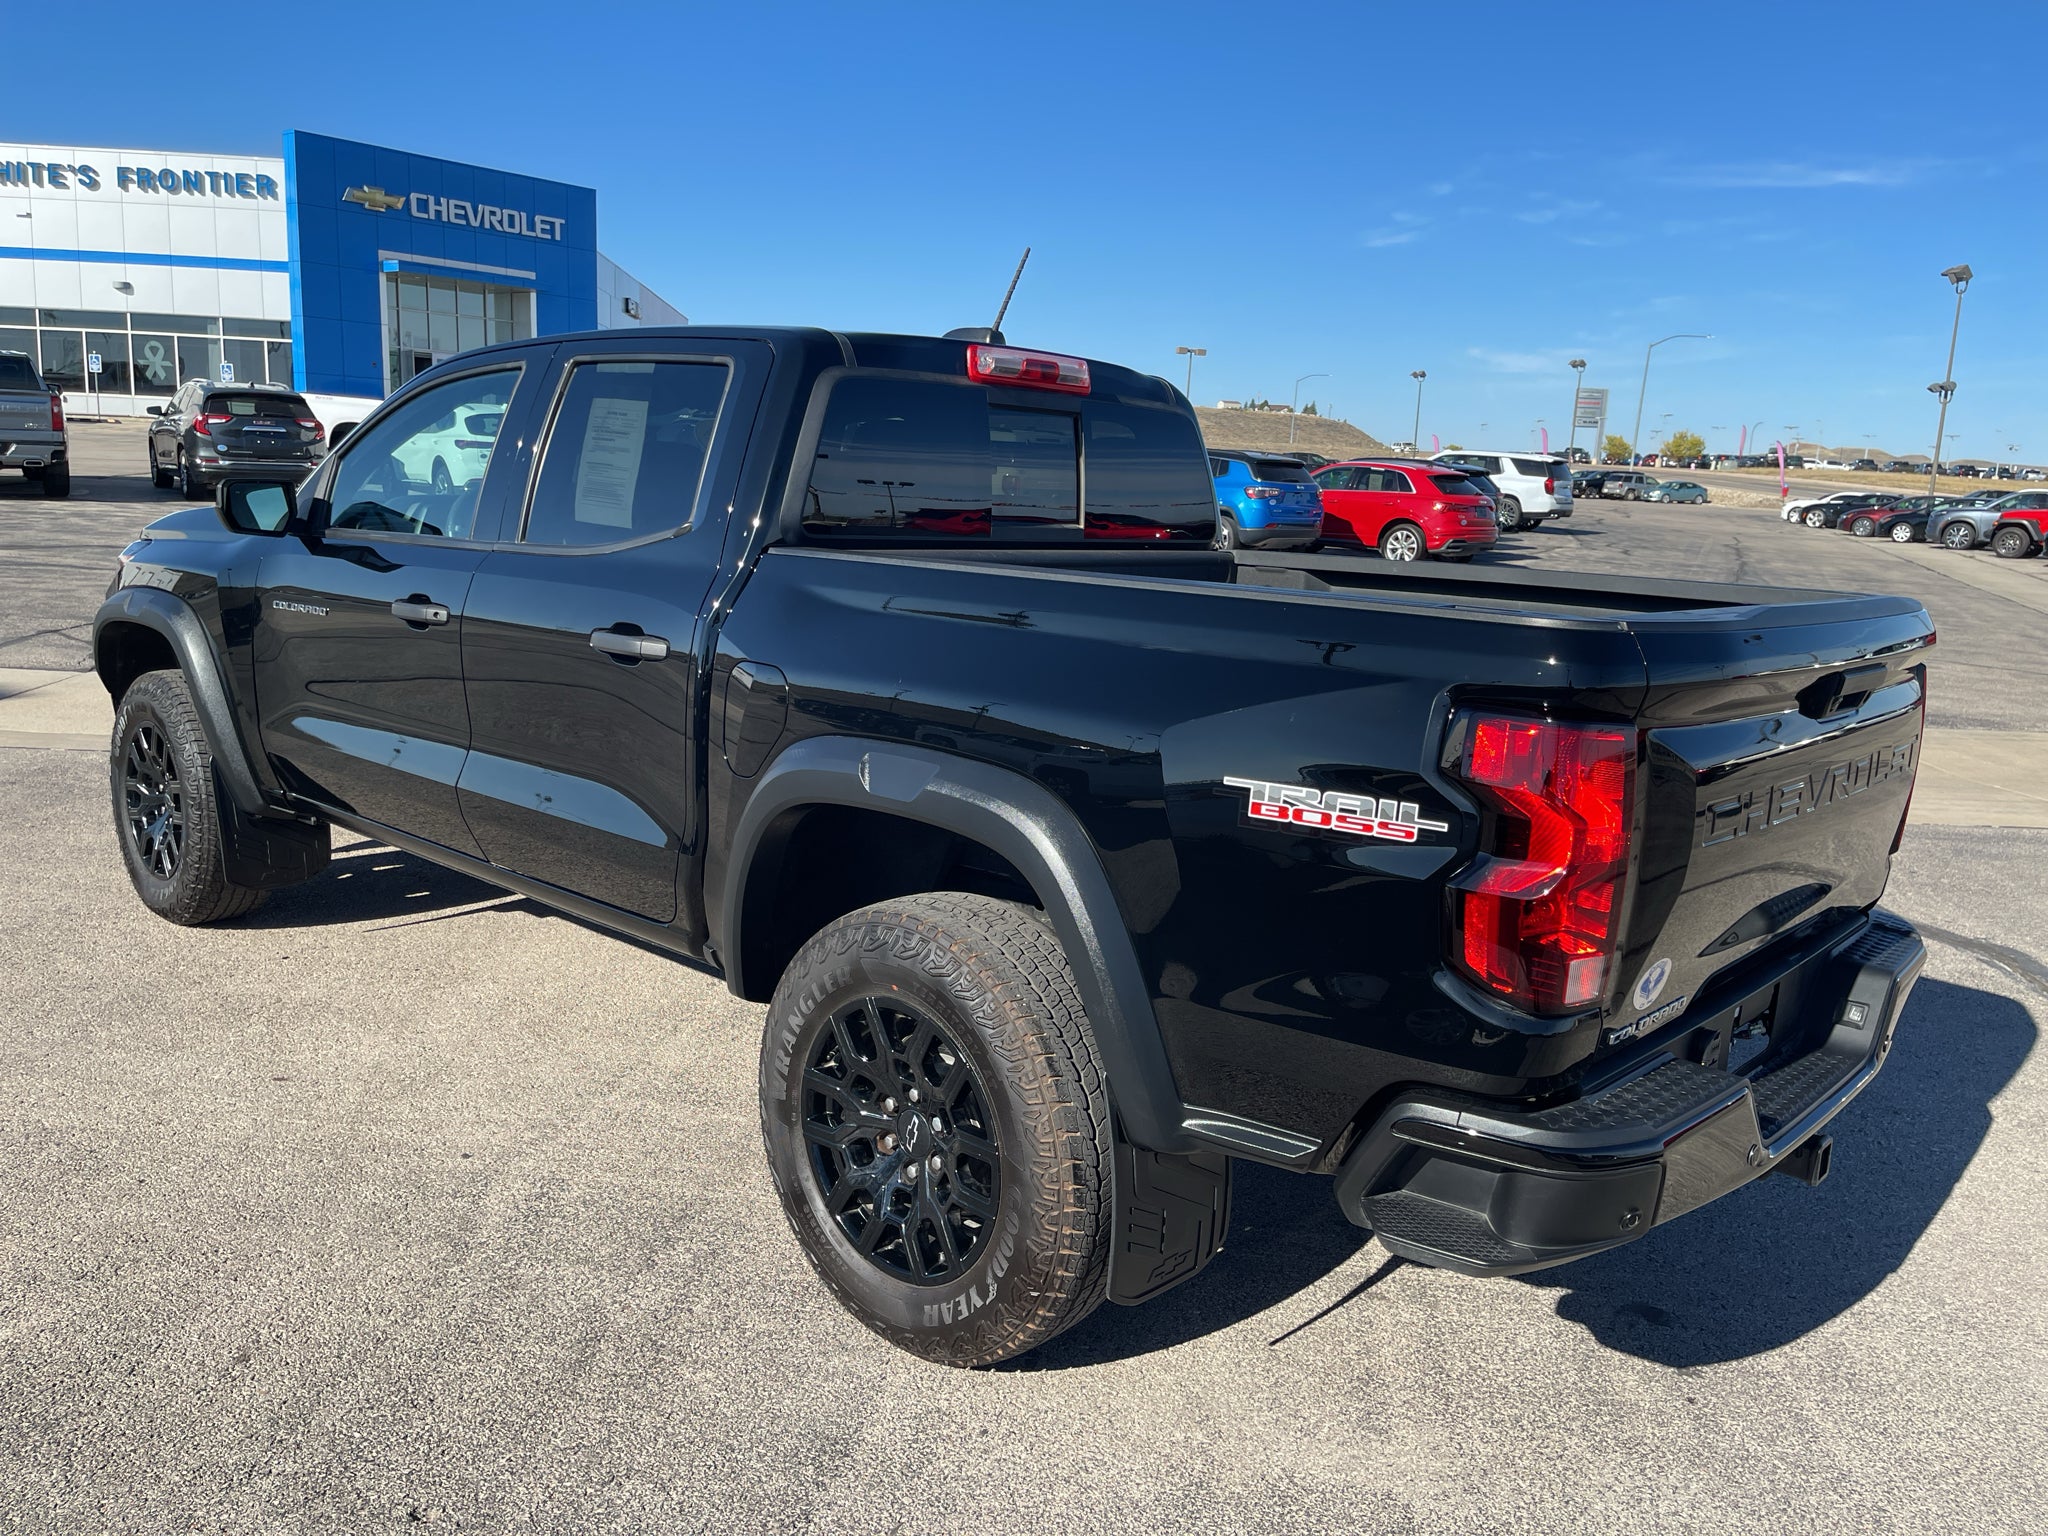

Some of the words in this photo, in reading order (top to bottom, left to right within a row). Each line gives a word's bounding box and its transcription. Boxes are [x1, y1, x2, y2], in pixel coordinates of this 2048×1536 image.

[116, 166, 278, 200] FRONTIER
[410, 192, 565, 241] CHEVROLET
[272, 600, 327, 616] COLORADO
[1223, 776, 1448, 832] TRAIL
[1702, 734, 1918, 847] CHEVROLET
[1248, 801, 1418, 842] BOSS
[772, 966, 854, 1100] WRANGLER
[1608, 995, 1687, 1045] COLORADO
